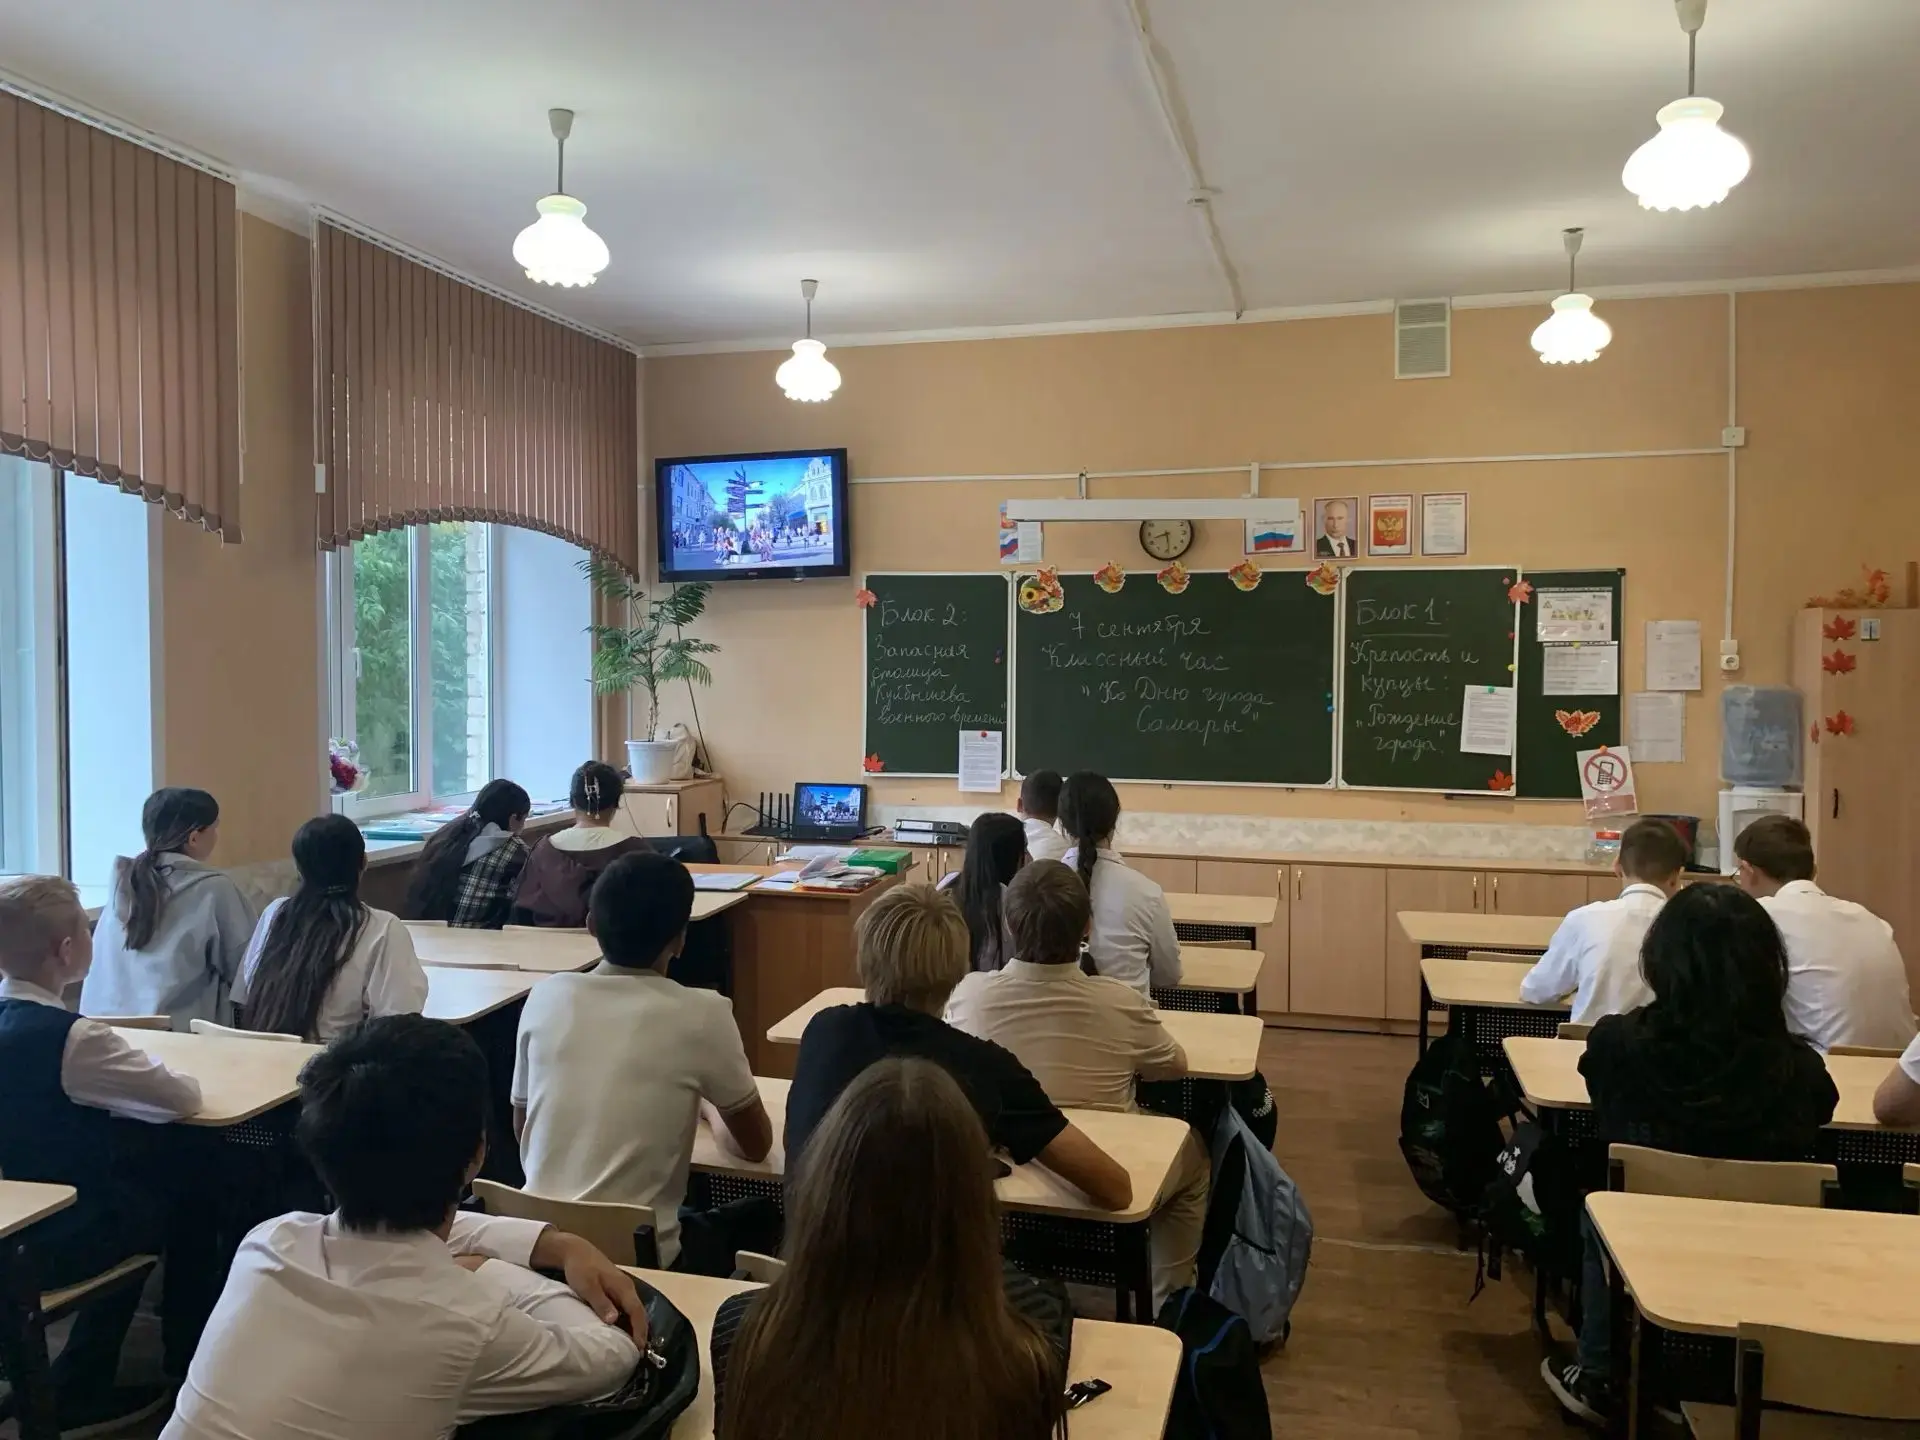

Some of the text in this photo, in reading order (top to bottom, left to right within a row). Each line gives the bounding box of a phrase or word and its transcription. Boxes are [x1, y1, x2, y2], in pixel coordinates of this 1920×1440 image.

[881, 600, 936, 627] Блок
[1356, 599, 1418, 626] Блок
[1068, 611, 1212, 644] 7 сентября
[874, 634, 970, 661] Запасная
[1041, 642, 1232, 671] Классный час
[1350, 639, 1480, 675] Крепость и
[1134, 676, 1189, 701] Дню
[1202, 687, 1274, 714] города
[877, 708, 946, 725] военного
